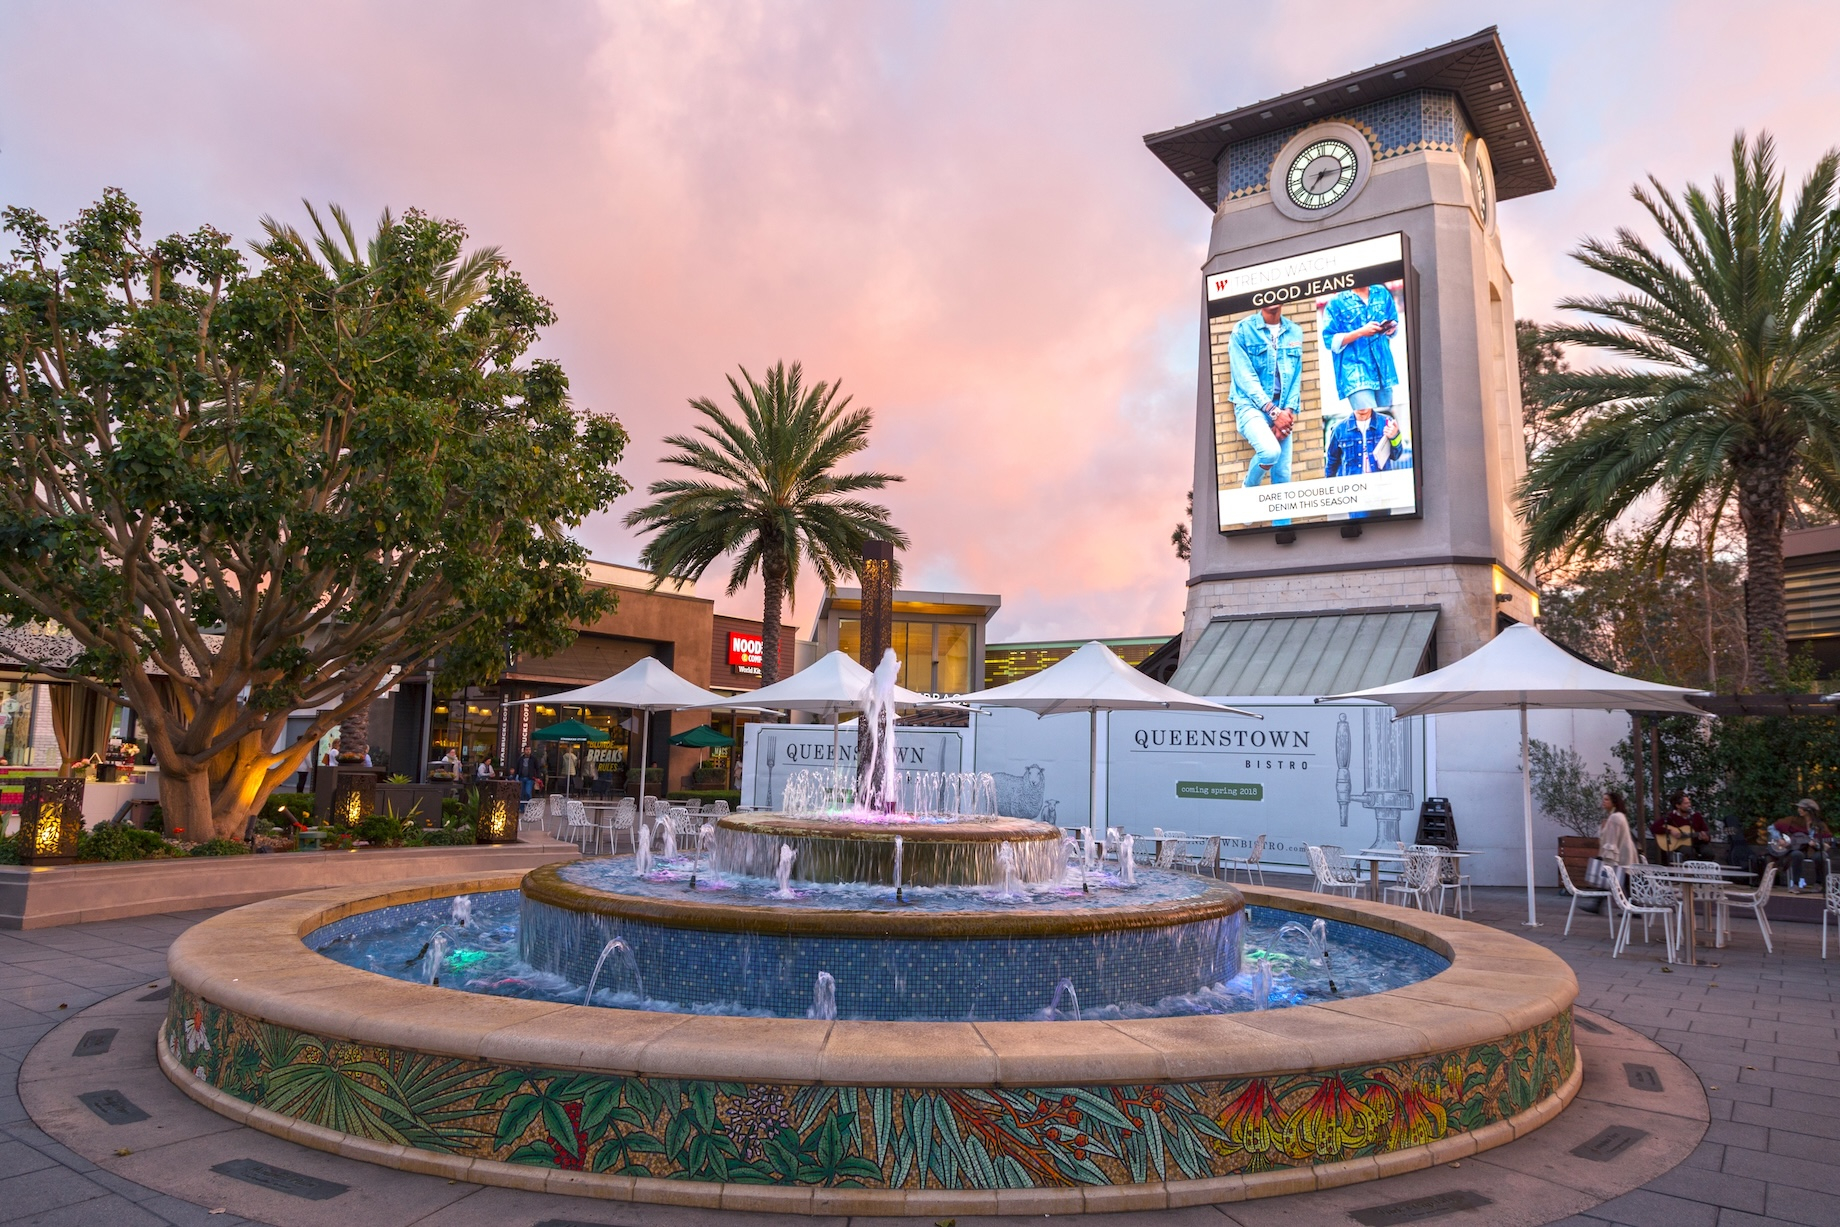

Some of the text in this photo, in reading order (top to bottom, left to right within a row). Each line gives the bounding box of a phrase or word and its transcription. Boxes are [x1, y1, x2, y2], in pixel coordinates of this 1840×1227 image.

[1235, 255, 1337, 287] TREND WATCH
[1252, 273, 1356, 306] GOOD JEANS
[1259, 483, 1367, 502] DARE TO DOUBLE UP ON
[1268, 495, 1358, 512] DENIM THIS SEASON
[733, 637, 763, 655] NOOD
[1135, 729, 1310, 748] QUEENSTOWN
[586, 748, 623, 763] BREAKS
[598, 763, 619, 772] RULES
[1245, 760, 1308, 770] BISTRO
[1181, 786, 1209, 795] coming
[1211, 787, 1237, 796] spring
